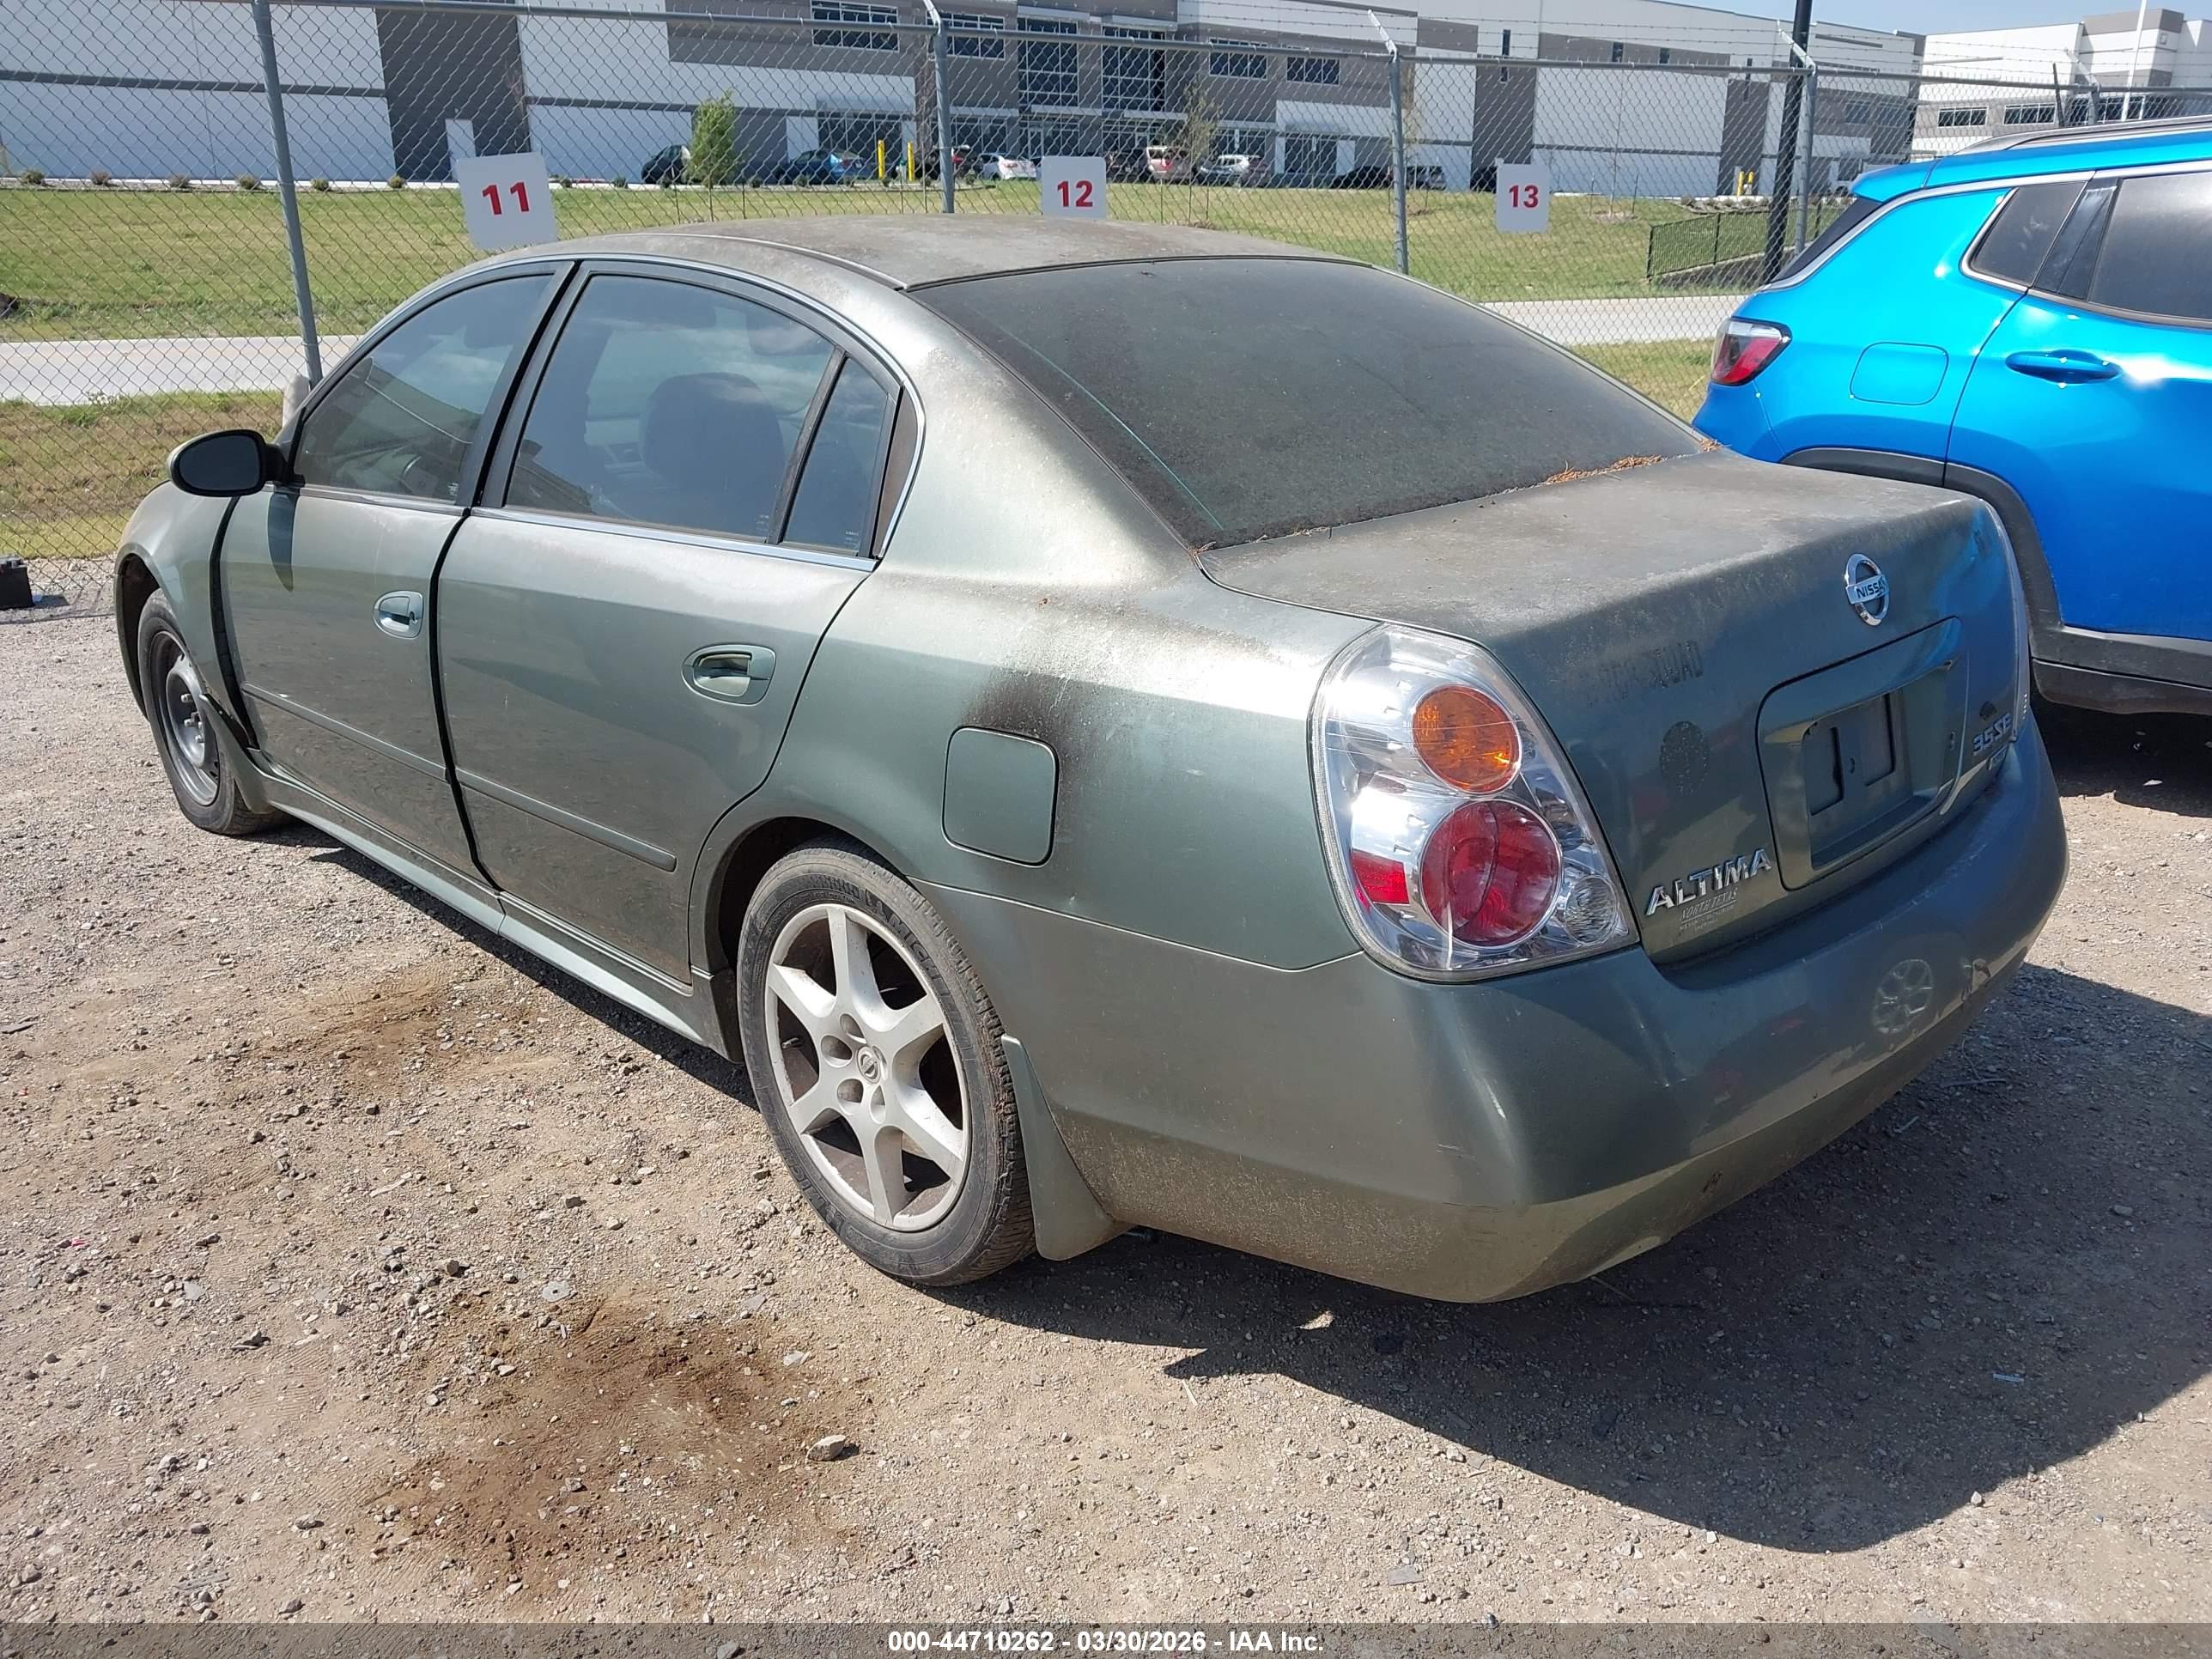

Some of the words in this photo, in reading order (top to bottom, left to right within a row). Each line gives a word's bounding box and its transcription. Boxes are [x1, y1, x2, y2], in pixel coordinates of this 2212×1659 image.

[482, 181, 530, 216] 11
[1057, 179, 1093, 208] 12
[1509, 184, 1539, 209] 13
[1645, 848, 1772, 916] ALTIMA
